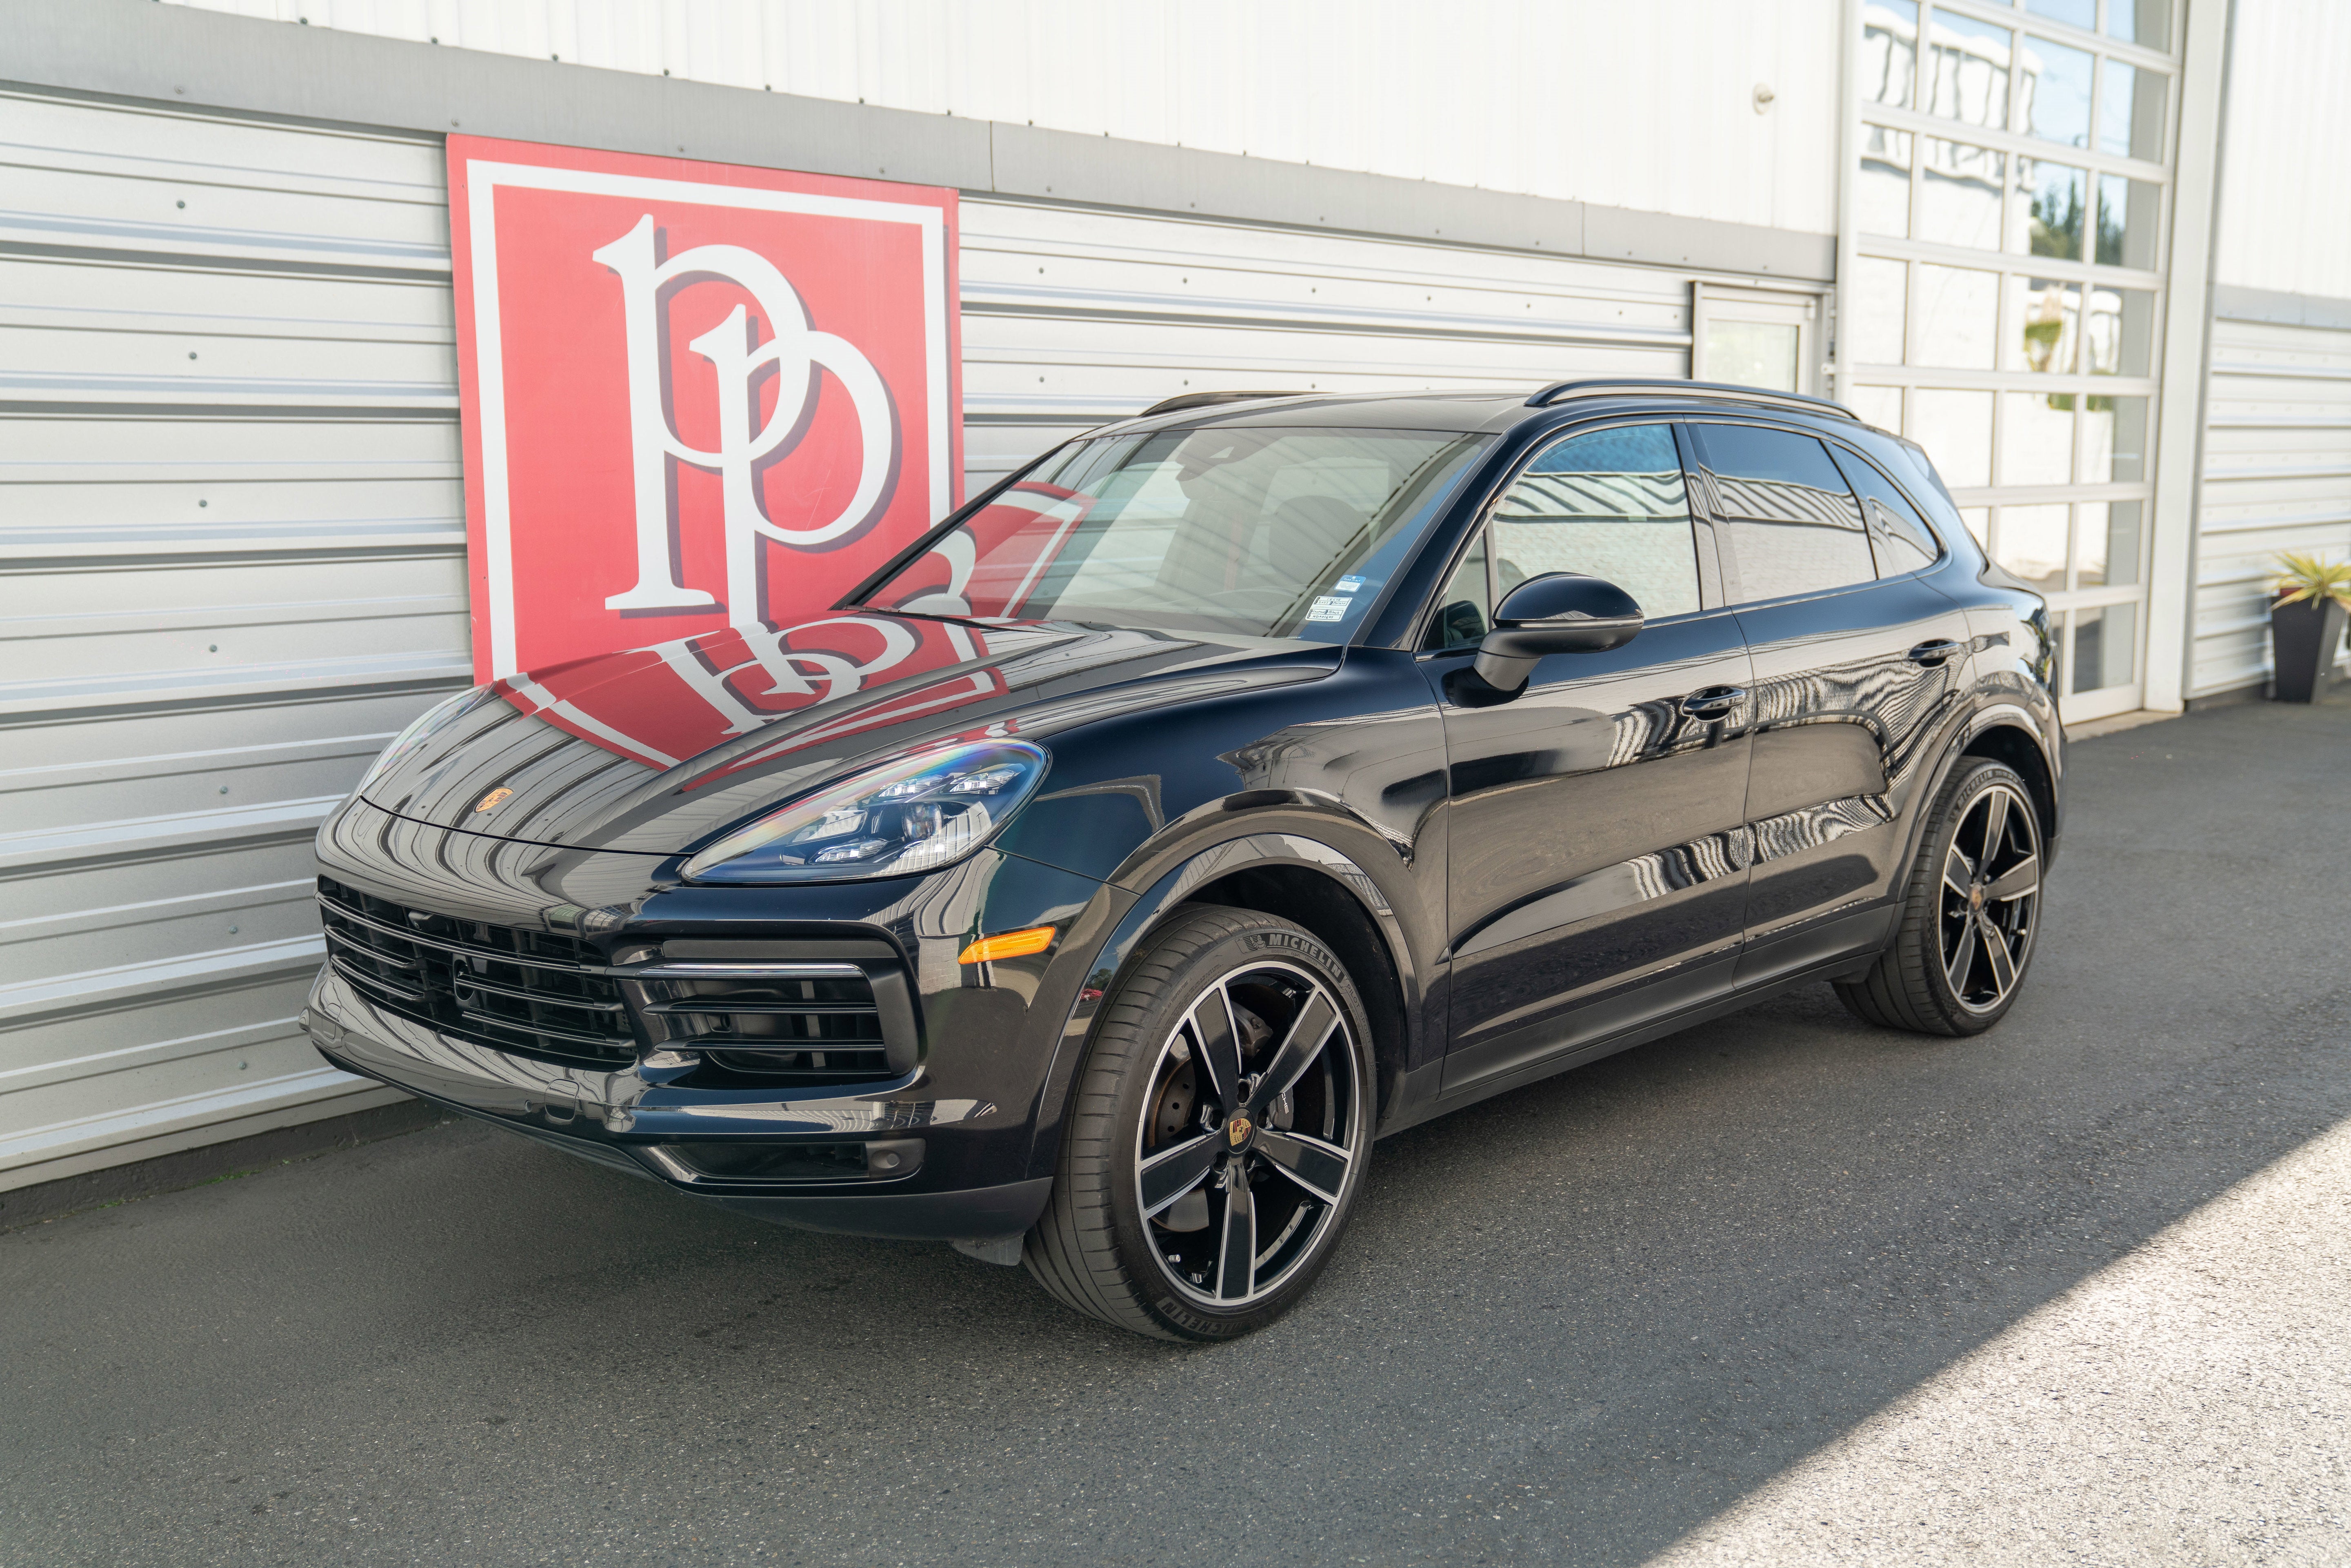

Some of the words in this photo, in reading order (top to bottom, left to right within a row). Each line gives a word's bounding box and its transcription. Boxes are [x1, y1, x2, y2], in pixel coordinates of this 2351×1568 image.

[1957, 770, 1993, 808] MICHELIN
[1269, 934, 1341, 977] MICHELIN
[1347, 984, 1360, 1007] PILOT
[1360, 1012, 1371, 1043] SPORT
[1161, 1301, 1243, 1334] MICHELIN
